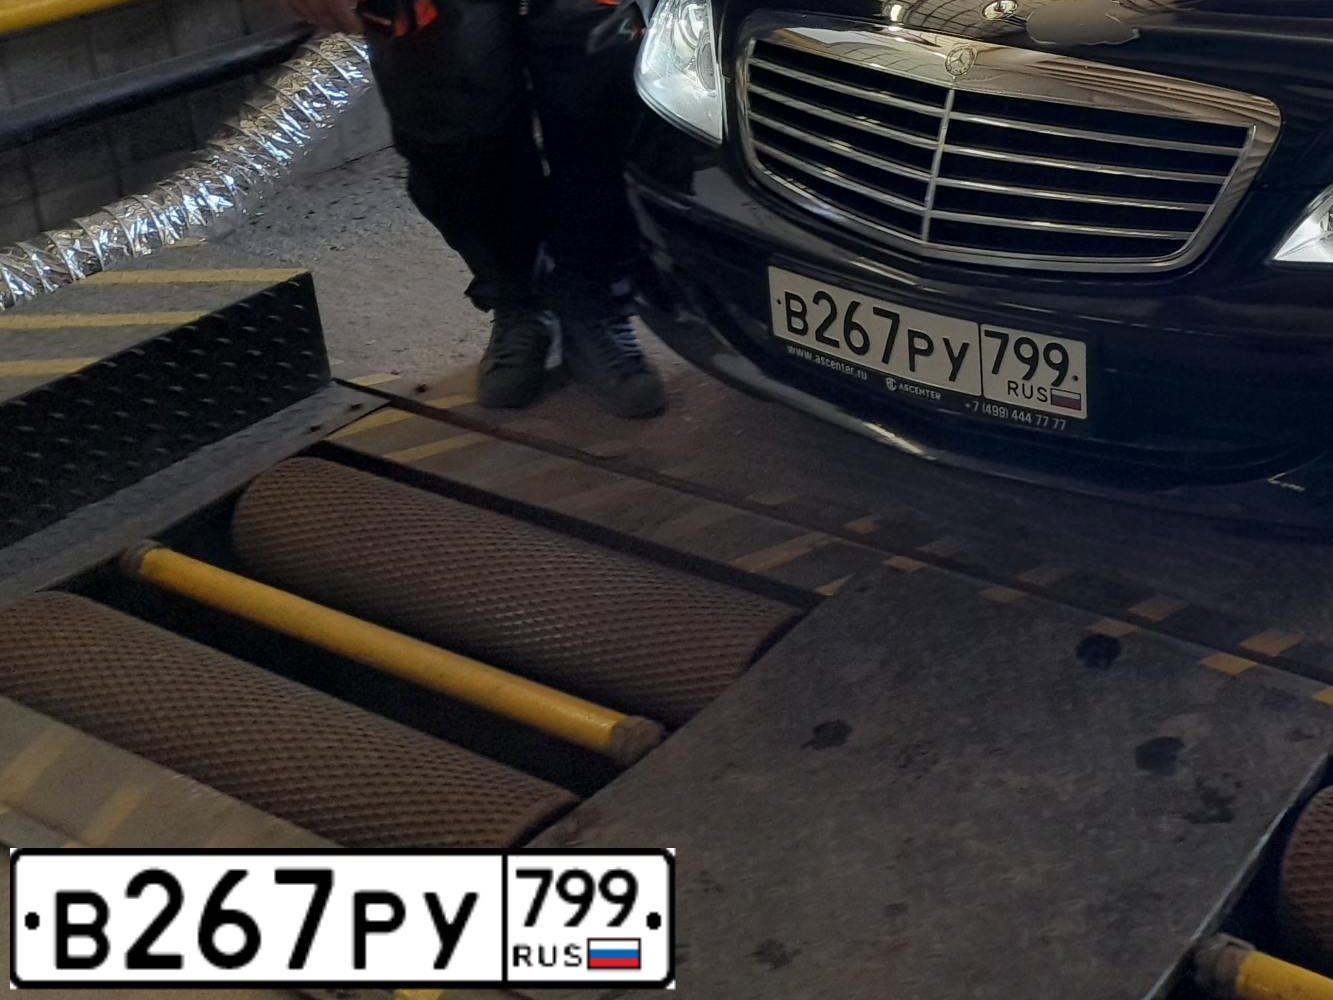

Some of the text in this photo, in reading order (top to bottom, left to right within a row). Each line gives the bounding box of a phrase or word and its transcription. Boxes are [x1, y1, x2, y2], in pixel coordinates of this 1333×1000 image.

[784, 291, 1070, 387] В267РУ 799
[898, 383, 942, 400] ASCENTER
[1007, 380, 1048, 403] RUS
[1011, 409, 1032, 423] 444
